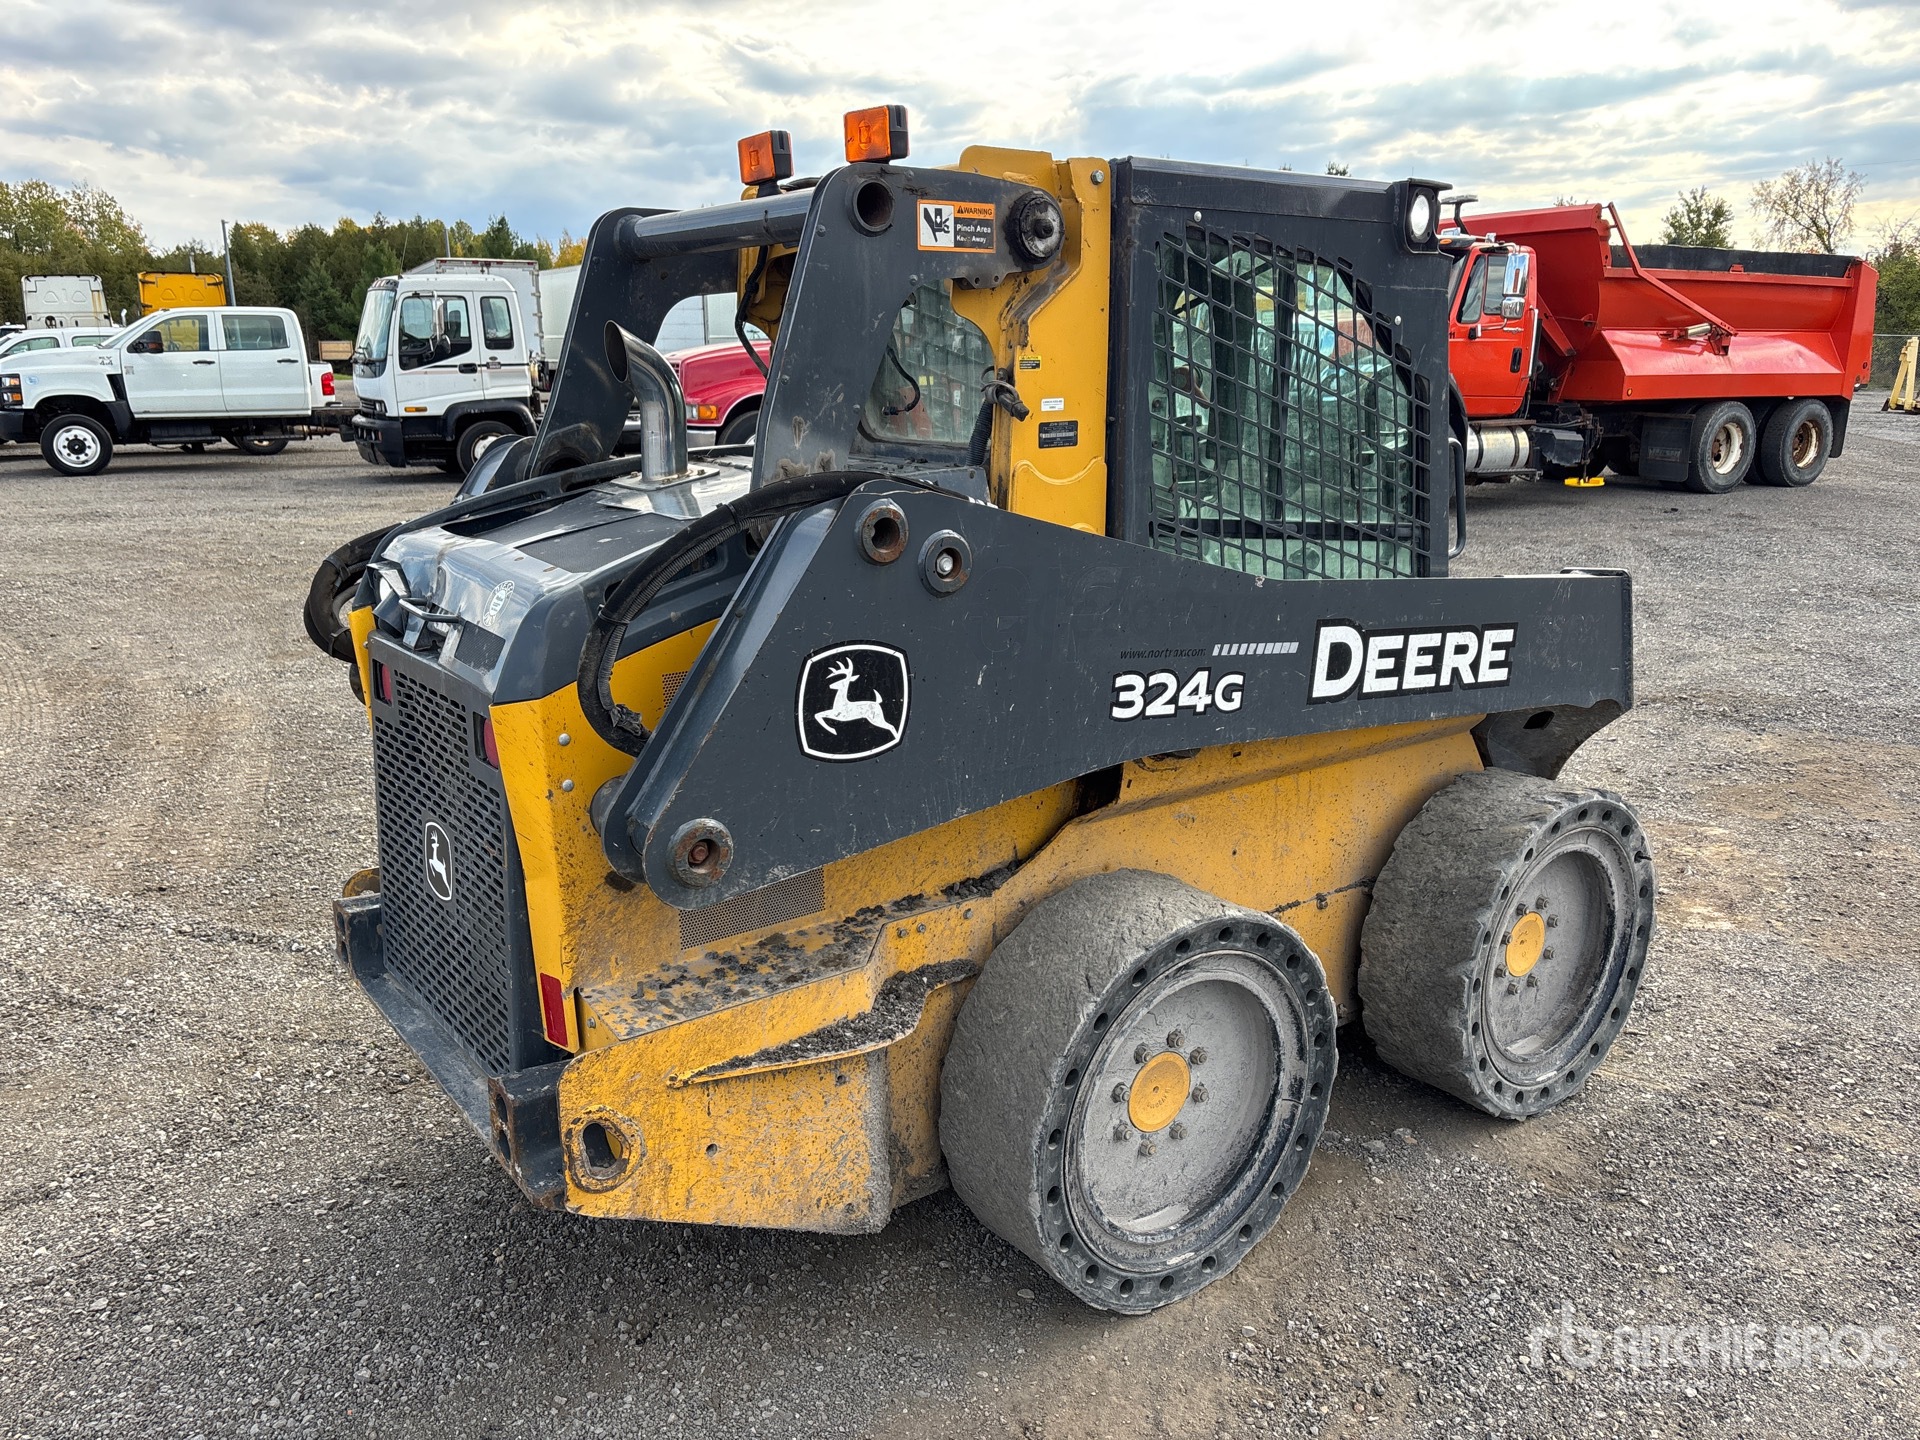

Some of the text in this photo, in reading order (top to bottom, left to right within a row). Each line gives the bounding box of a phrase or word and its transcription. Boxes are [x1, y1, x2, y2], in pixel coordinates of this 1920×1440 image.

[963, 206, 993, 216] WARNING
[956, 224, 991, 233] Pinch Area
[971, 235, 987, 244] Away
[1311, 625, 1515, 699] DEERE
[1110, 669, 1245, 720] 324G
